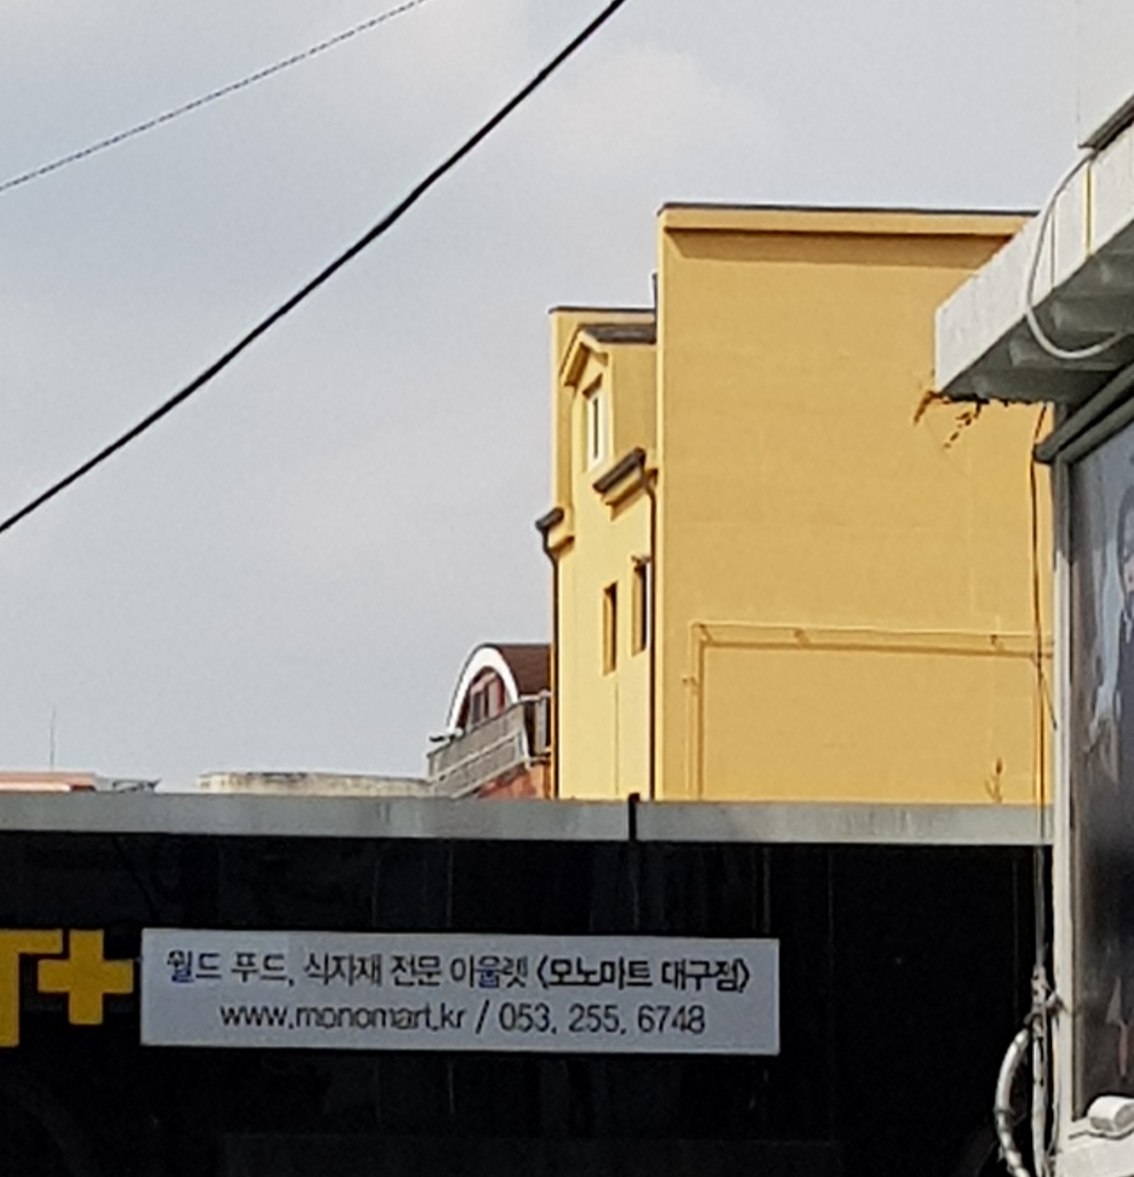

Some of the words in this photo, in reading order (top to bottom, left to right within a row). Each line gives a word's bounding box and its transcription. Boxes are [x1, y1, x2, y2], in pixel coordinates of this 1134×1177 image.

[166, 949, 223, 984] 월드
[303, 952, 383, 987] 식자재
[390, 953, 443, 987] 전문
[220, 1002, 467, 1032] www.monomart.kr
[636, 1004, 706, 1035] 6748
